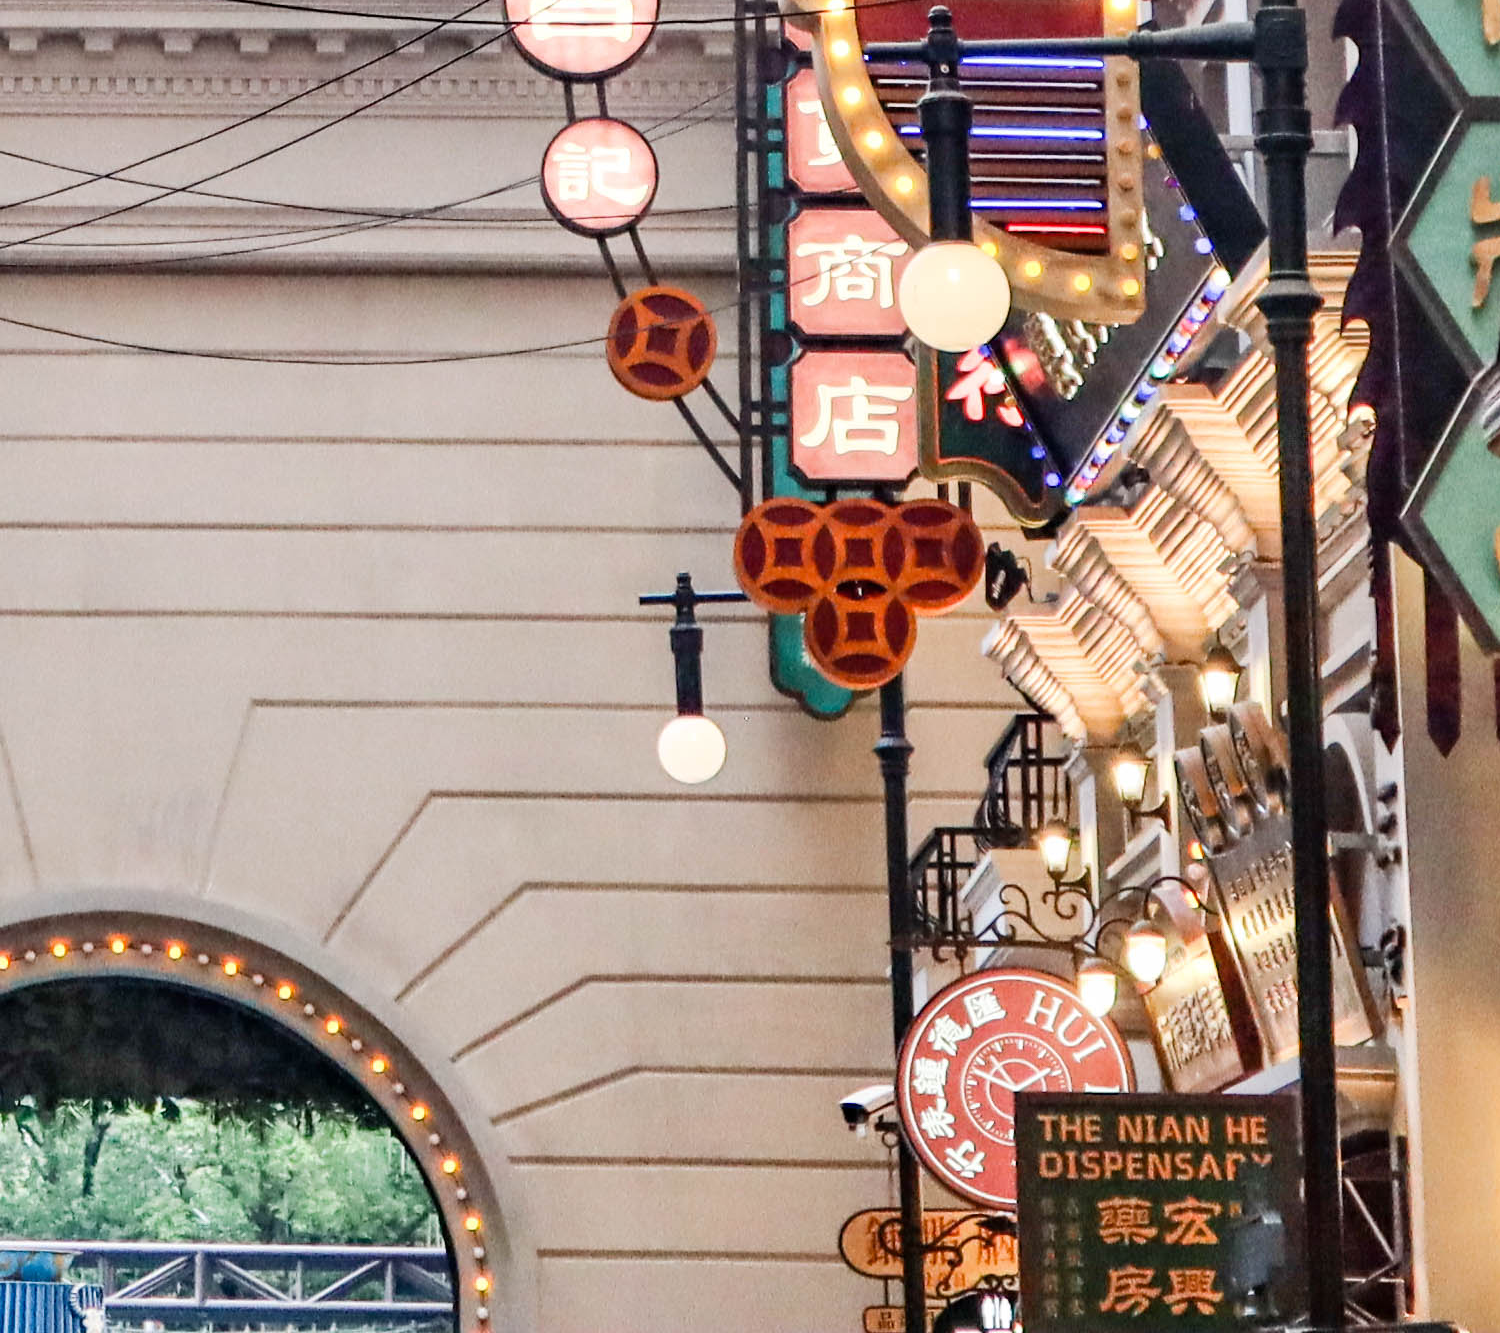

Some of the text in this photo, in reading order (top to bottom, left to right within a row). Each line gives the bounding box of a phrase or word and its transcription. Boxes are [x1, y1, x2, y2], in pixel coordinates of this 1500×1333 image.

[1025, 990, 1107, 1064] HUI
[1037, 1114, 1268, 1145] THE NIAN HE
